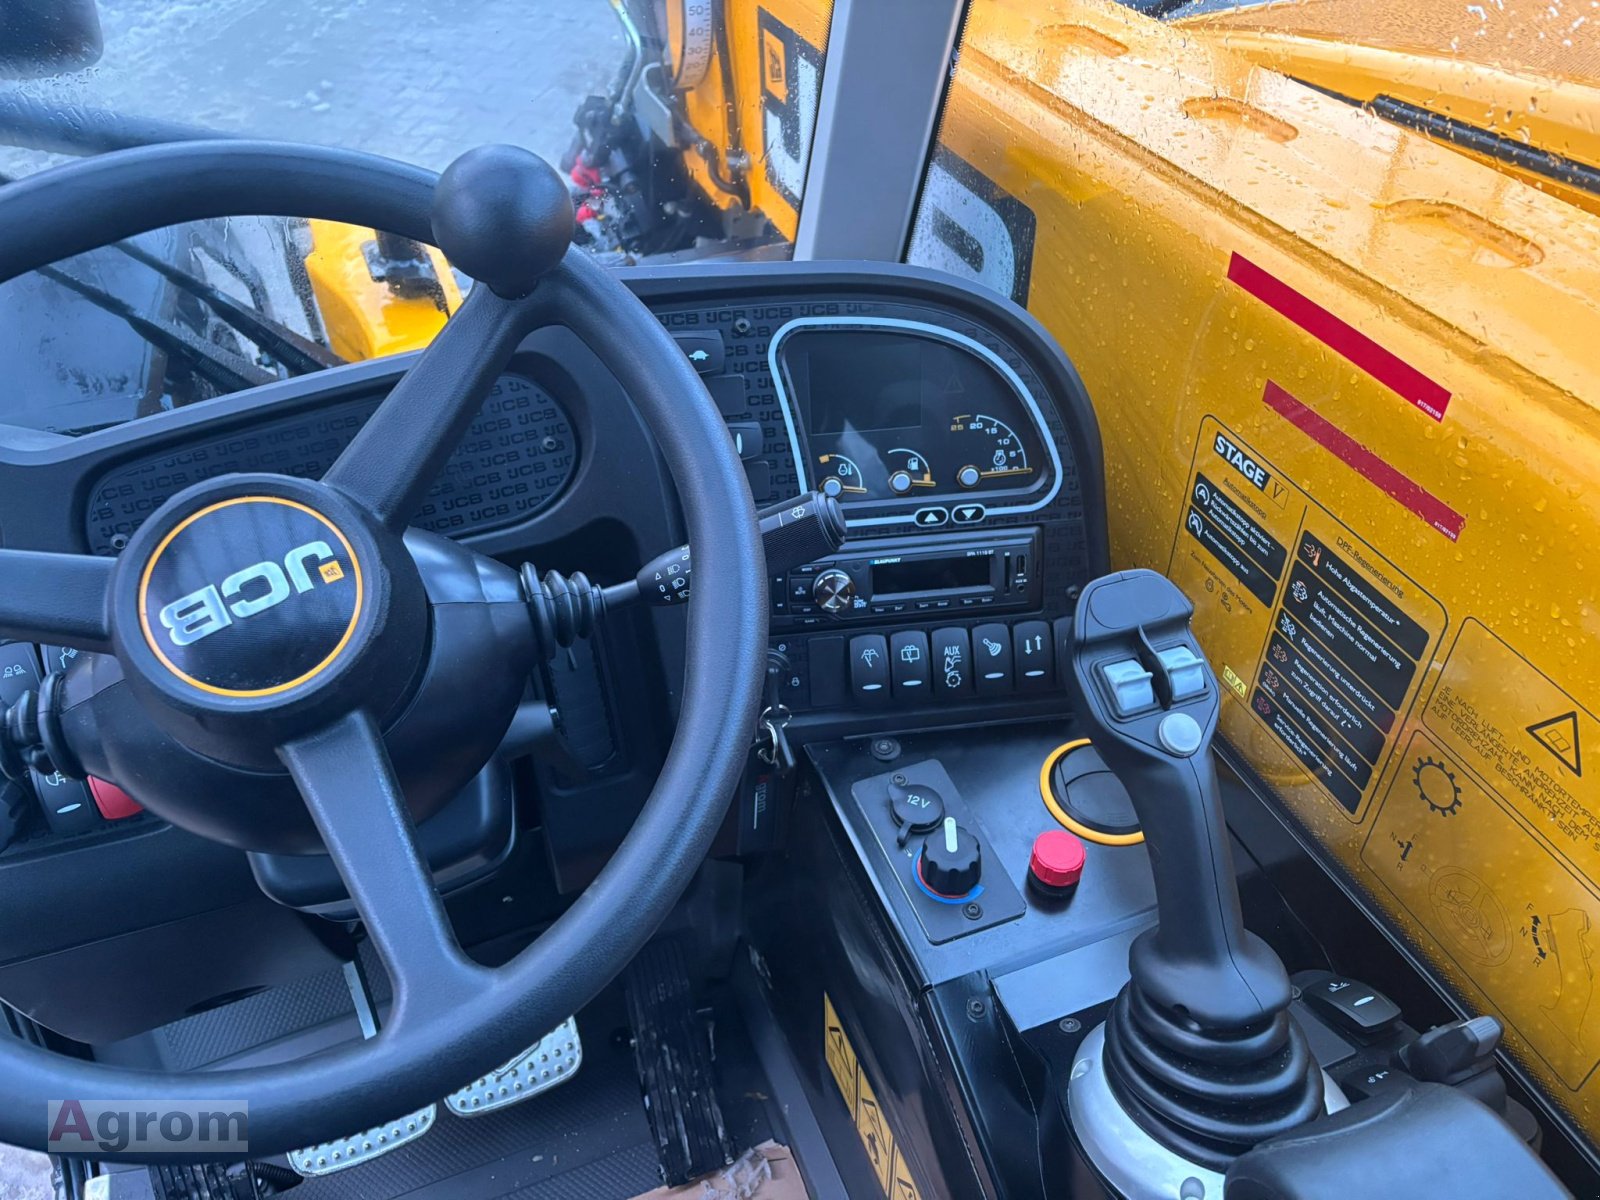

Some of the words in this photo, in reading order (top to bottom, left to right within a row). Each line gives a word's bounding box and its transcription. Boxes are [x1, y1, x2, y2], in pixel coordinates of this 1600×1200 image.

[688, 5, 704, 16] 50
[688, 27, 703, 36] 40
[753, 307, 793, 320] JCB
[800, 304, 839, 316] JCB
[489, 395, 530, 413] JCB
[518, 410, 557, 425] JCB
[969, 422, 983, 430] 20
[471, 419, 512, 436] JCB
[499, 432, 538, 448] JCB
[481, 452, 521, 468] JCB
[1213, 435, 1268, 487] STAGE
[1270, 482, 1284, 499] V
[508, 463, 547, 479] JCB
[142, 473, 188, 491] JCB
[489, 485, 529, 502] JCB
[442, 497, 483, 512] JCB
[470, 505, 510, 522] JCB
[1207, 509, 1246, 545] Automatikstopp
[1203, 529, 1241, 566] Automatikstopp
[1248, 535, 1257, 545] bis
[1256, 544, 1268, 556] zum
[1324, 561, 1343, 579] Hohe
[1336, 536, 1405, 598] DPF-Regenerierung
[159, 541, 334, 646] JCB
[1308, 612, 1335, 639] bedienen
[1317, 589, 1357, 628] Automatische
[1355, 625, 1402, 668] Regenerierung
[1326, 614, 1355, 642] Maschine
[1353, 639, 1377, 662] normal
[944, 646, 960, 656] AUX
[1290, 671, 1303, 684] zum
[1299, 637, 1342, 679] Regenerierung
[1338, 676, 1376, 711] unterdrückt
[1292, 659, 1329, 696] Regeneration
[1327, 693, 1363, 728] erforderlich
[1281, 692, 1306, 720] Manuelle
[1304, 716, 1345, 759] Regenerierung
[1342, 755, 1358, 771] läuft
[1454, 695, 1478, 718] NACH
[1511, 746, 1530, 764] UND
[1274, 714, 1333, 776] Service-Regenerierung
[1437, 691, 1455, 709] EINE
[1458, 709, 1519, 766] VERLÄNGERTE
[1523, 768, 1579, 818] ANDREHZEIT
[1430, 705, 1447, 721] AUF
[1449, 722, 1492, 761] LEERLAUF
[1556, 820, 1578, 841] SEIN
[1434, 698, 1505, 764] MOTORDREHZAHL
[1509, 765, 1535, 790] KANN
[1537, 792, 1564, 818] NACH
[1567, 819, 1589, 840] DEM
